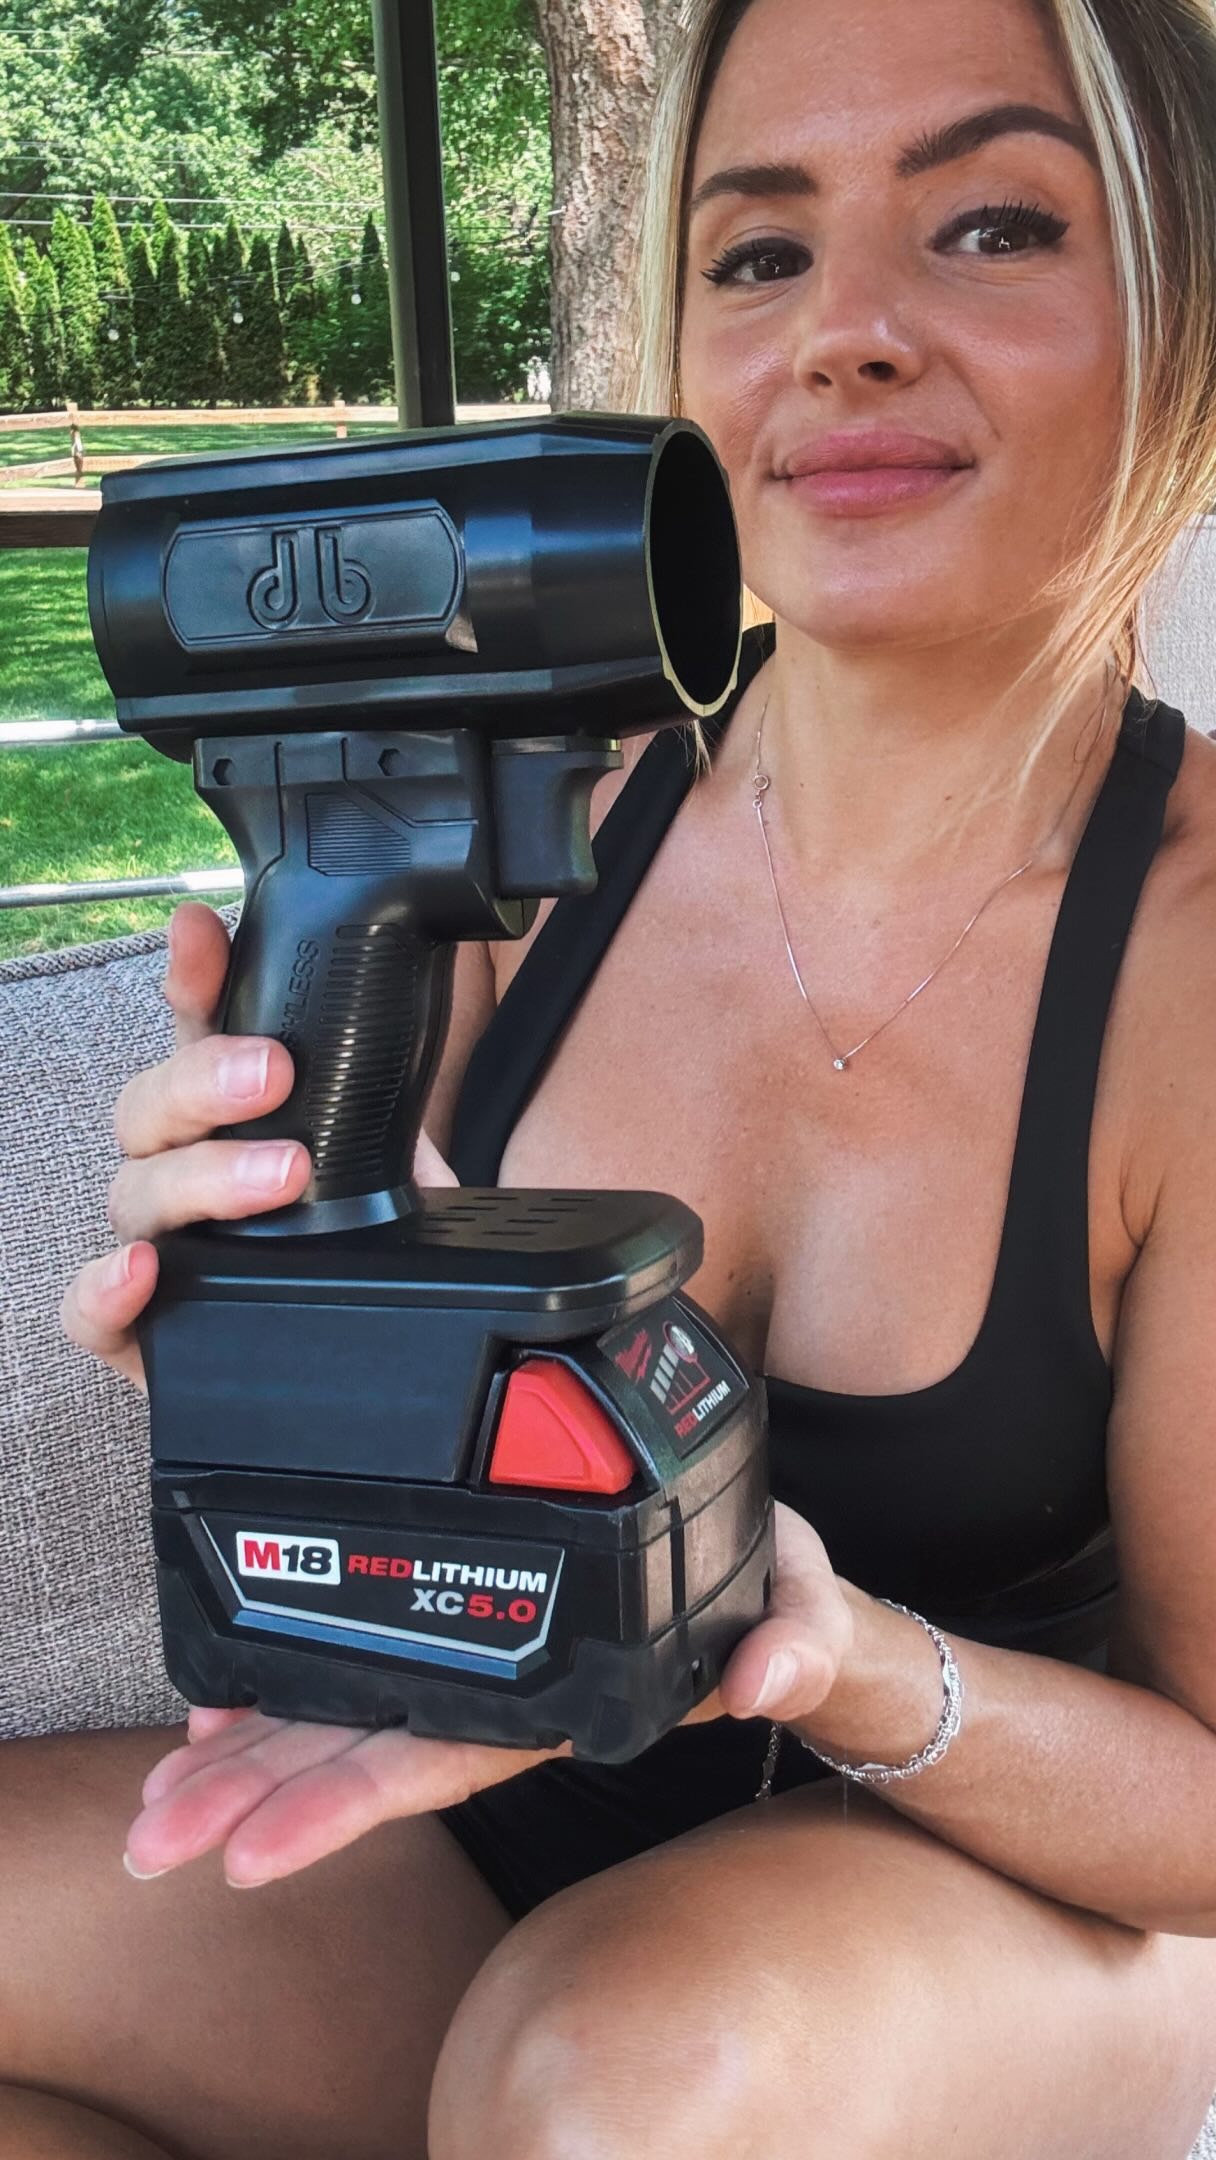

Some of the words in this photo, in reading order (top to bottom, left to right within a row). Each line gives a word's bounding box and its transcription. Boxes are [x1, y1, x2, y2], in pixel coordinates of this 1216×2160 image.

[674, 1380, 731, 1438] REDLITHIUM
[243, 1539, 333, 1576] M18
[348, 1554, 548, 1593] REDLITHIUM
